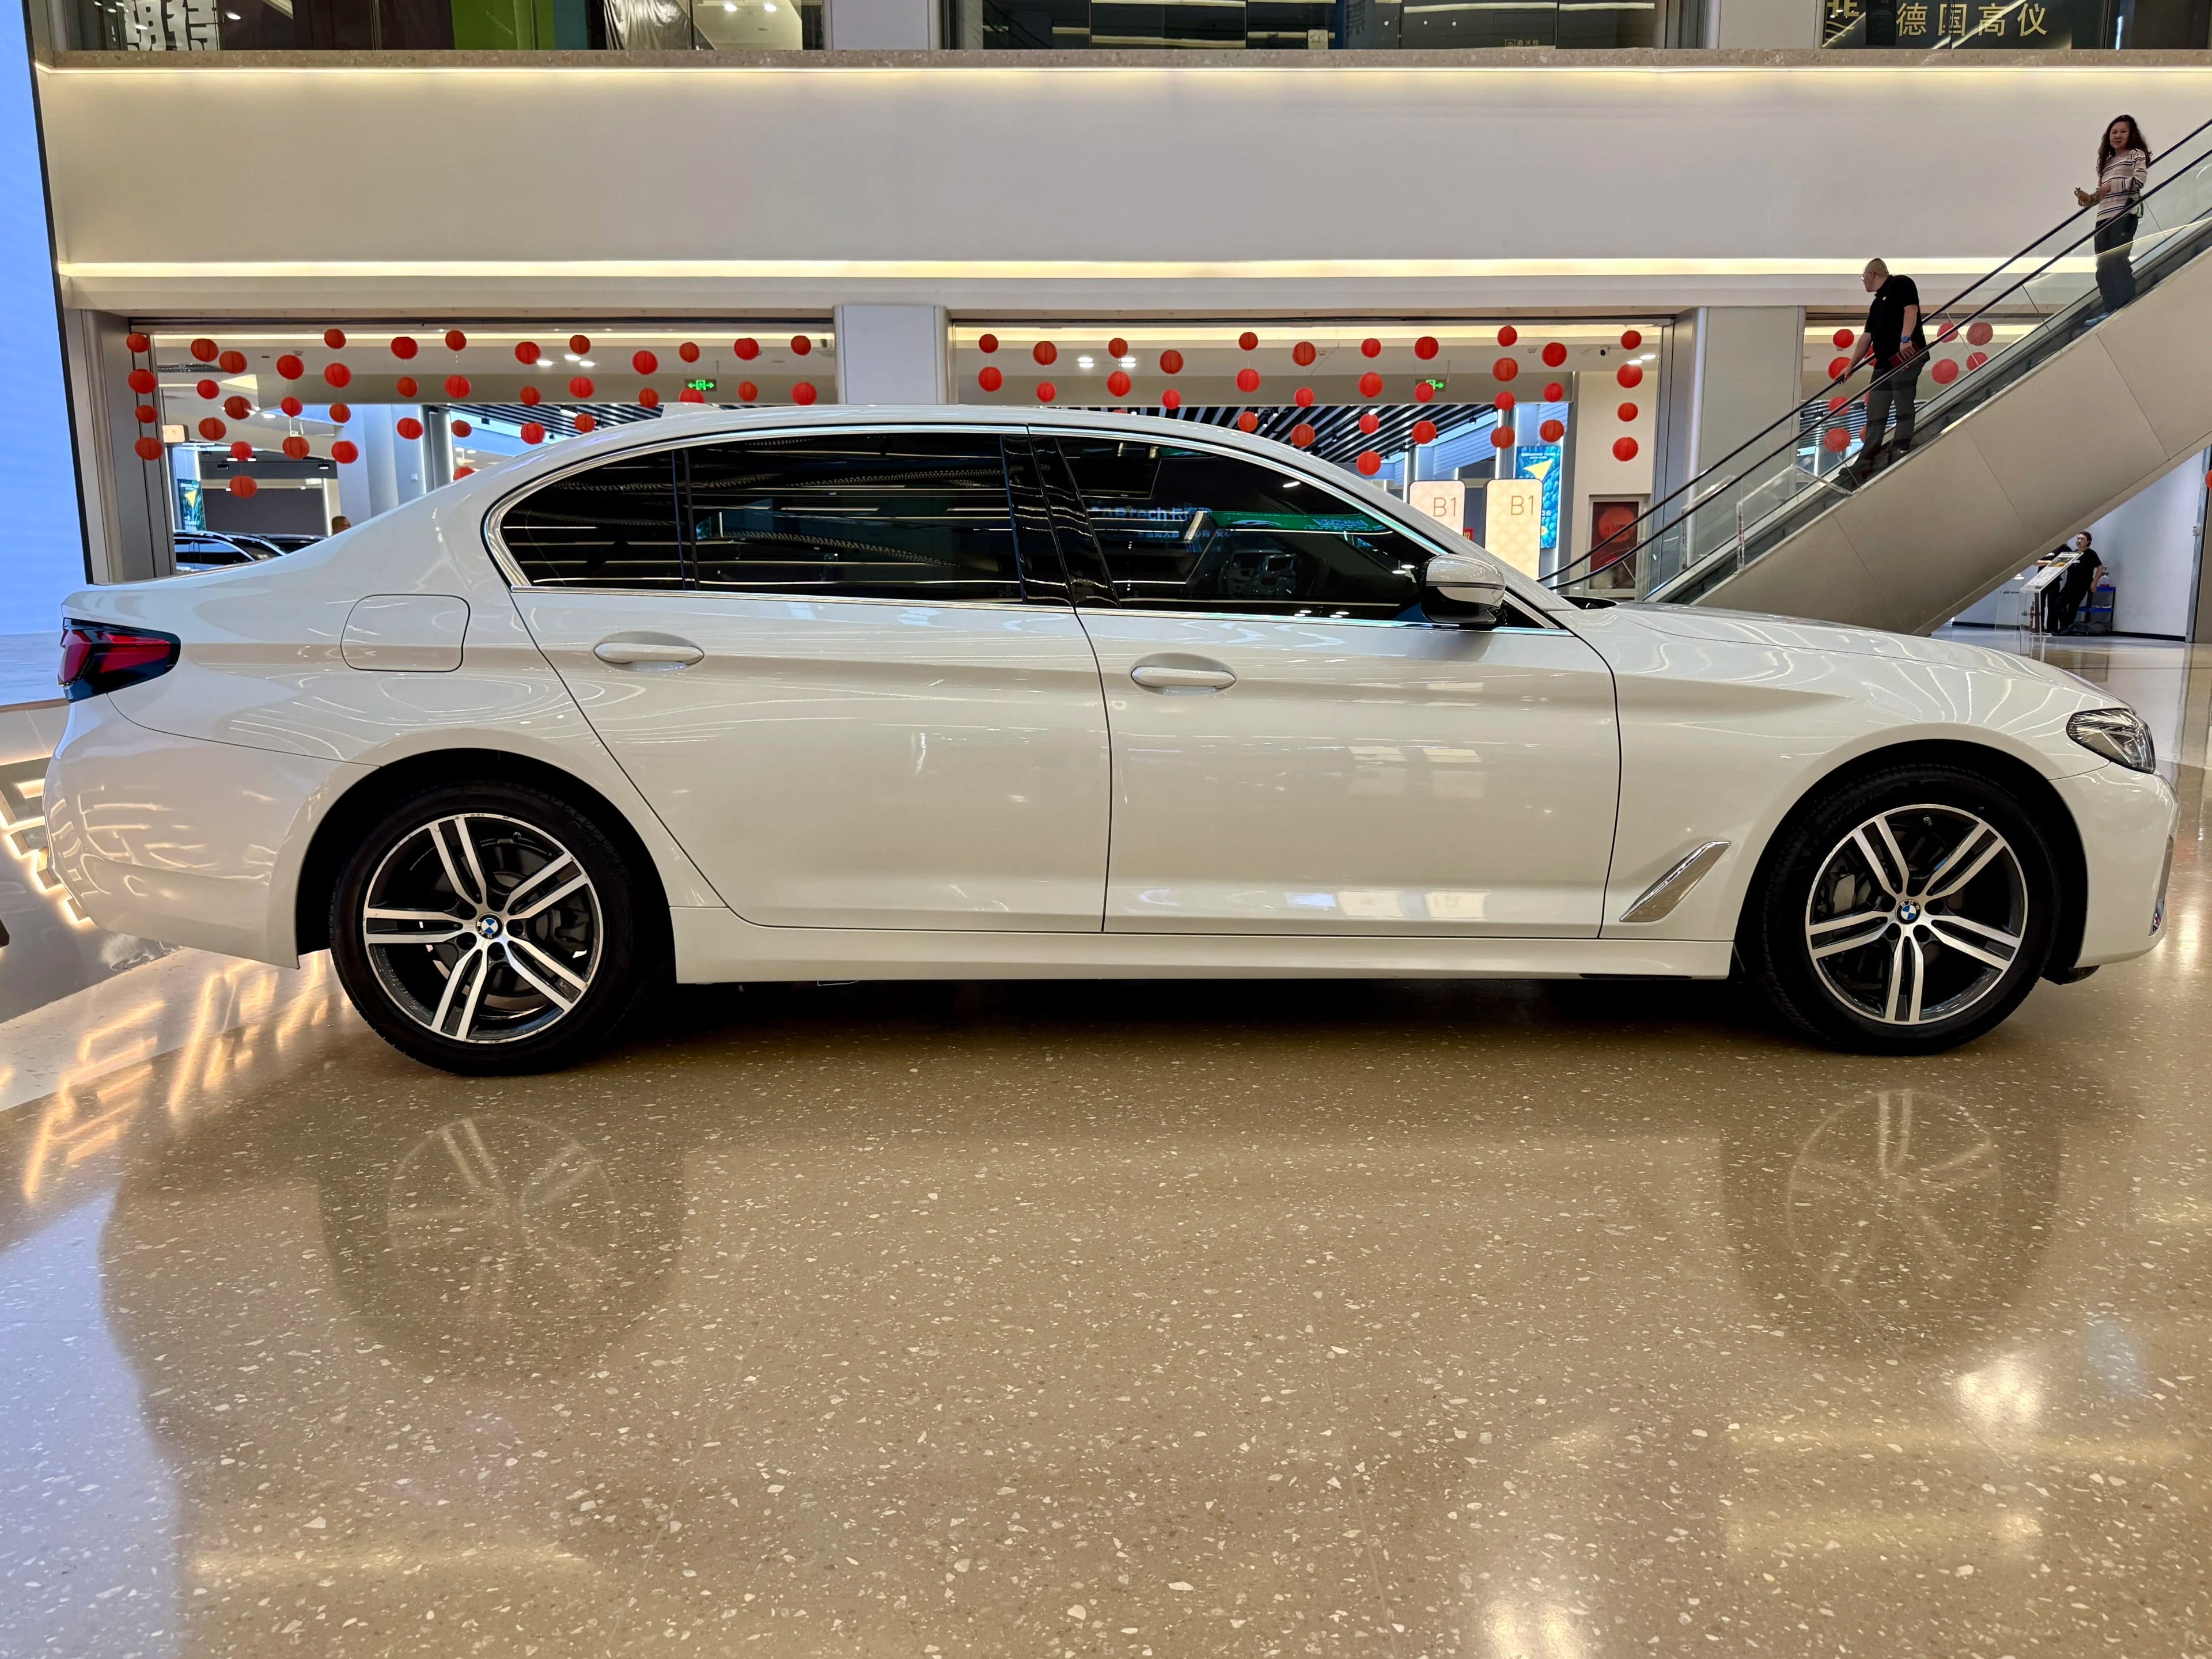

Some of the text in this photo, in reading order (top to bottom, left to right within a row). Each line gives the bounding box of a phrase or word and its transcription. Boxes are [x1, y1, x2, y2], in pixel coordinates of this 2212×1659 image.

[1896, 3, 2048, 37] 德国高仪
[1433, 497, 1456, 517] B1
[1510, 495, 1534, 516] B1
